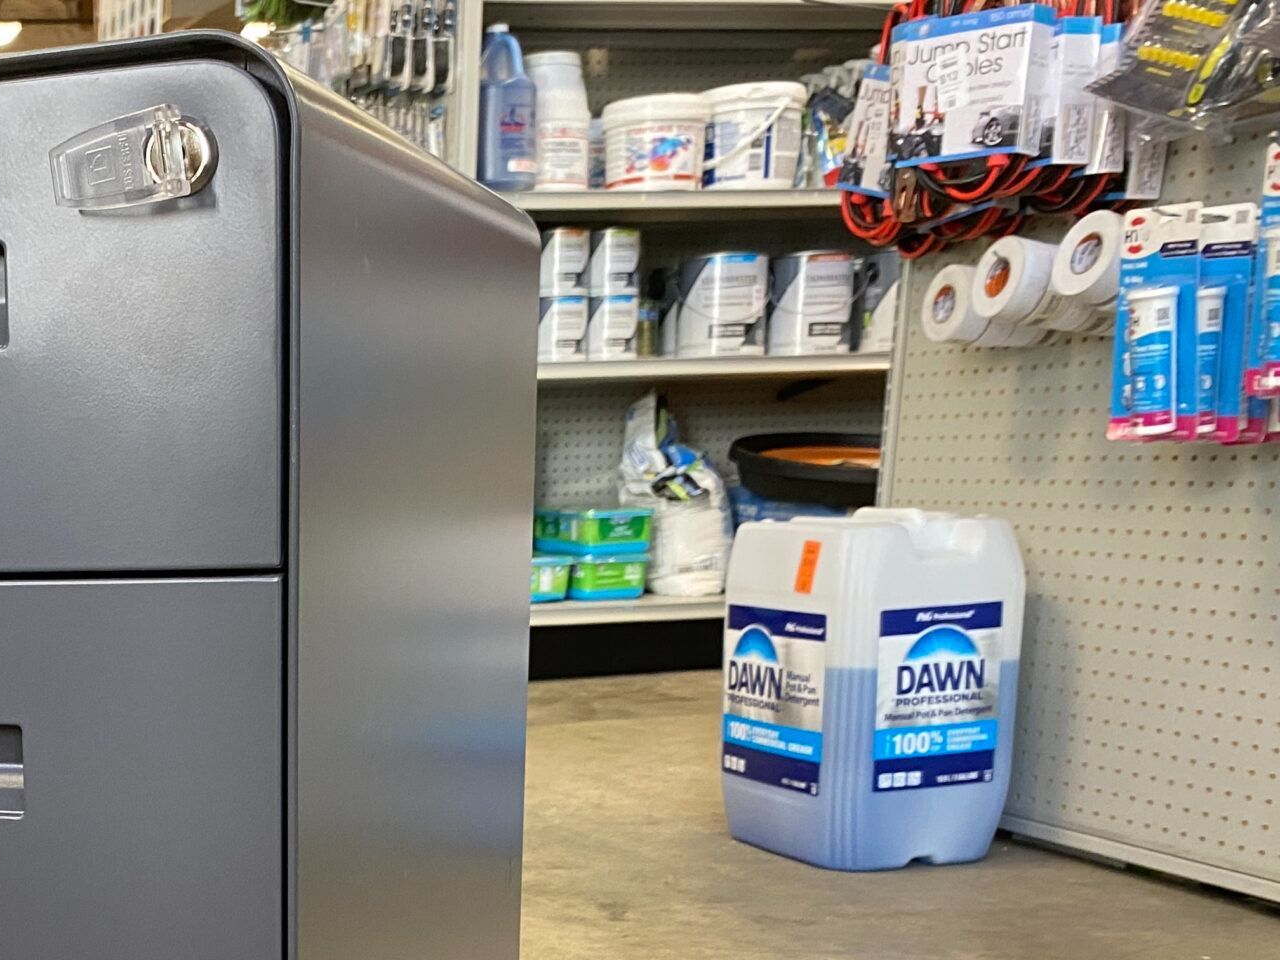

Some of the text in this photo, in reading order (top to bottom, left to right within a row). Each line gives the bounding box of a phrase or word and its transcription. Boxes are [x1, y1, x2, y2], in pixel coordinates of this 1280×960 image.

[908, 26, 1027, 66] Jump Start
[926, 56, 1003, 84] Cles
[729, 660, 783, 700] DAWN
[787, 671, 811, 682] Manual
[896, 659, 985, 695] DAWN
[727, 693, 782, 713] PROFESSIONAL
[895, 691, 984, 707] PROFESSIONAL
[884, 710, 916, 722] Manual
[938, 708, 953, 718] Pan
[892, 731, 944, 755] 100%
